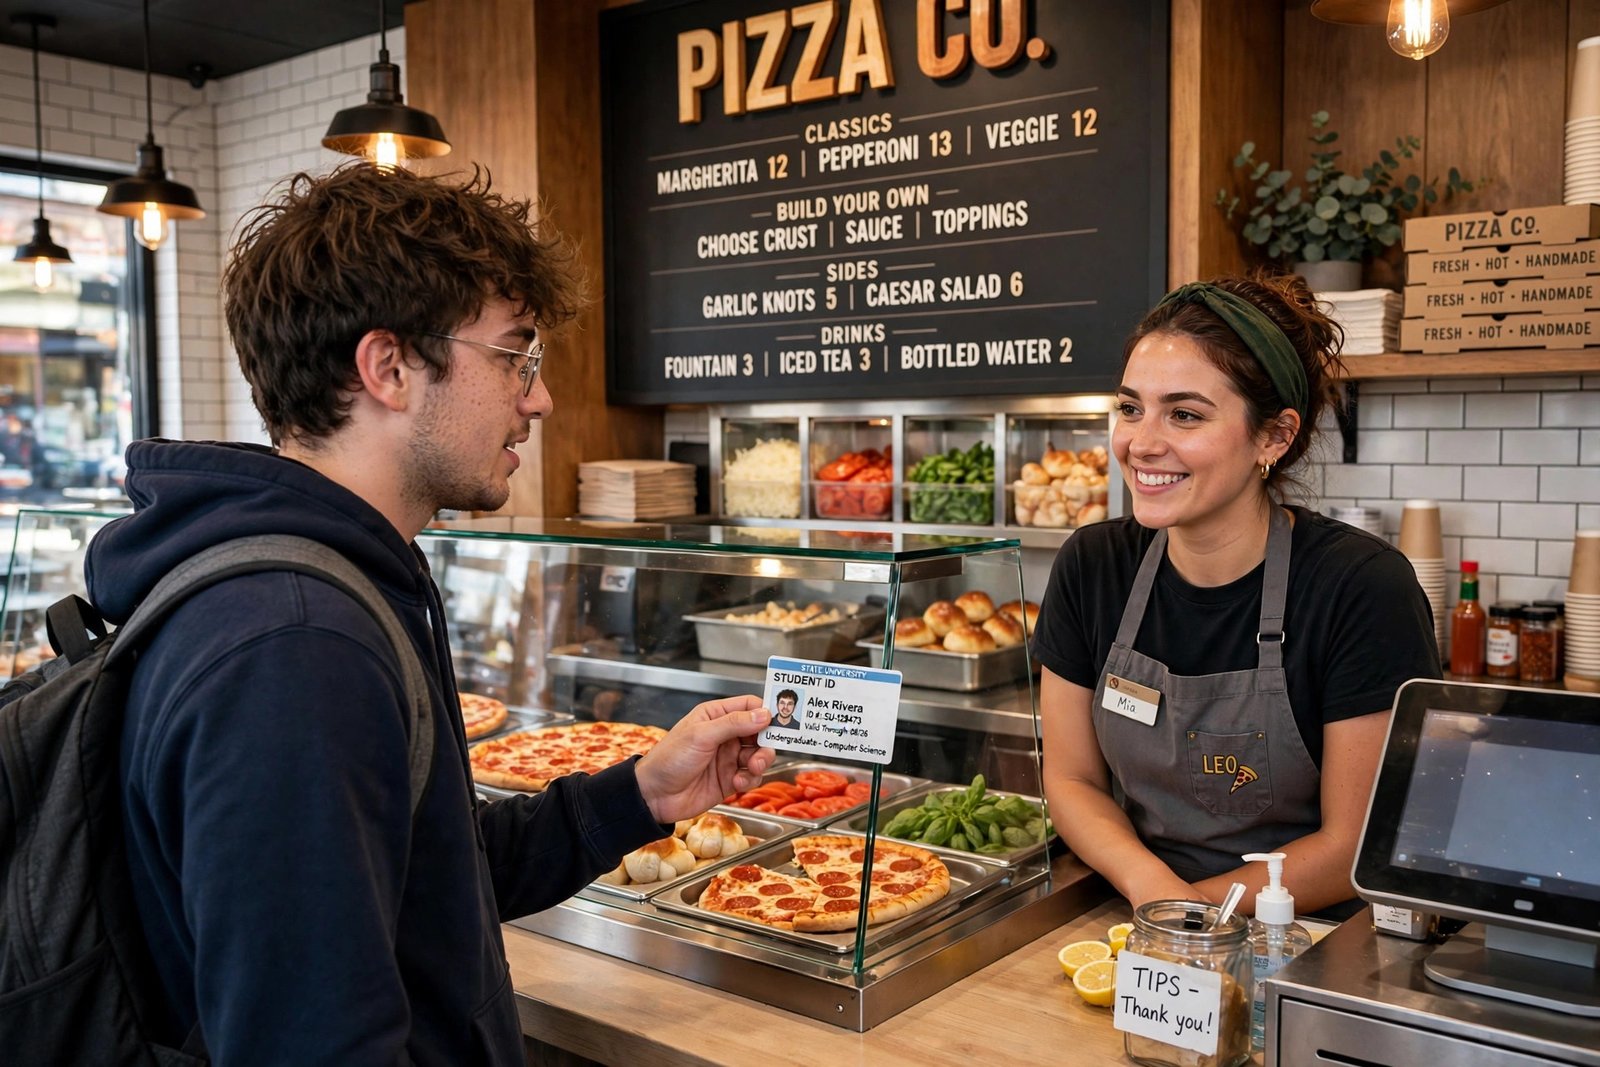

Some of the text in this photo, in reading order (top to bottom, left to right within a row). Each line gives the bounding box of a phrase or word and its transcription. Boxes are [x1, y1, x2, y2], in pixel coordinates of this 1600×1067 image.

[677, 0, 1051, 124] PIZZA CO.
[805, 113, 892, 144] CLASSICS
[657, 108, 1098, 195] MARGHERITA 12 PEPPERONI 13 VEGGIE 12
[776, 184, 929, 222] BUILD YOUR OWN
[697, 200, 1029, 259] CHOOSE CRUST SAUCE TOPPINGS
[1445, 218, 1502, 242] PIZZA
[826, 260, 879, 283] SIDES
[1433, 250, 1596, 273] FRESH HOT HANDMADE
[702, 271, 1024, 319] GARLIC KNOTS 5 CAESAR SALAD 6
[1427, 285, 1593, 307] FRESH HOT HANDMADE
[820, 323, 886, 345] DRINKS
[1424, 321, 1592, 341] FRESH HOT HANDMADE
[664, 337, 1074, 379] FOUNTAIN 3 ICED TEA 3 BOTTLED WATER 2
[773, 672, 836, 689] STUDENT ID
[801, 665, 867, 679] STATE UNIVERSITY
[806, 710, 814, 719] ID
[807, 697, 864, 714] Alex Rivera
[1117, 697, 1136, 713] Mia
[804, 722, 821, 732] Valid
[765, 731, 818, 746] Undergraduate
[823, 740, 858, 753] Computer
[859, 745, 887, 757] Science
[1203, 755, 1237, 774] LEO
[1132, 967, 1181, 997] TIPS
[1120, 995, 1213, 1036] Thank you!
